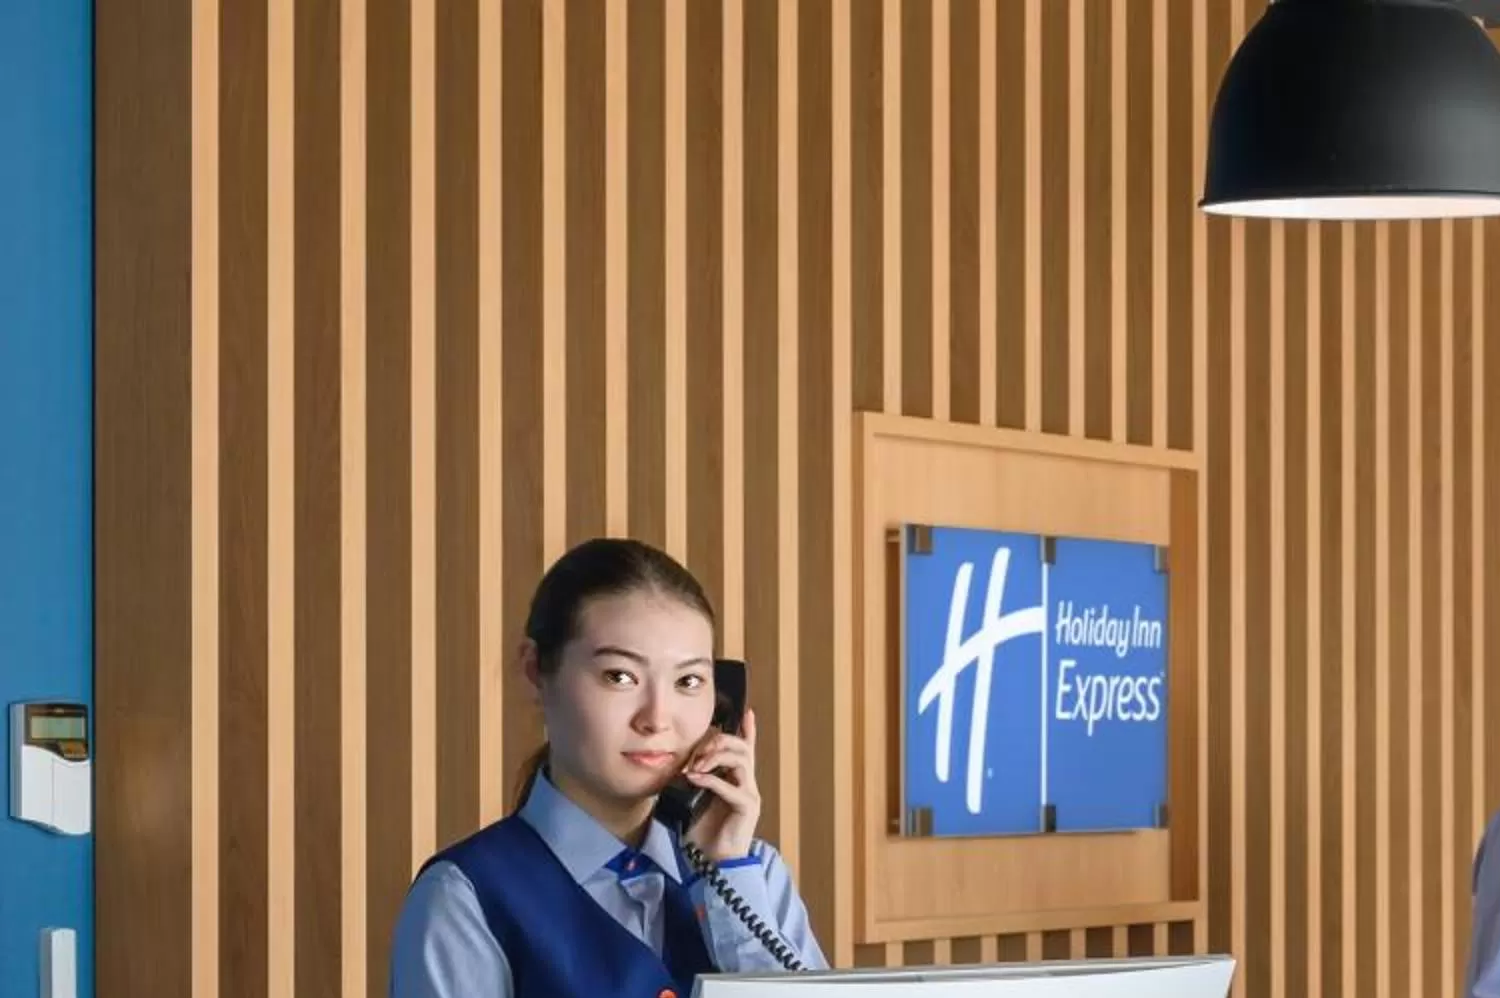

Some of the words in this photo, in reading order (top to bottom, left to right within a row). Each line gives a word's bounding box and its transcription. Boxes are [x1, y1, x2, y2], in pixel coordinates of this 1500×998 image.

[1056, 600, 1130, 658] Holiday
[1132, 604, 1162, 648] Inn
[1056, 660, 1162, 737] Express
